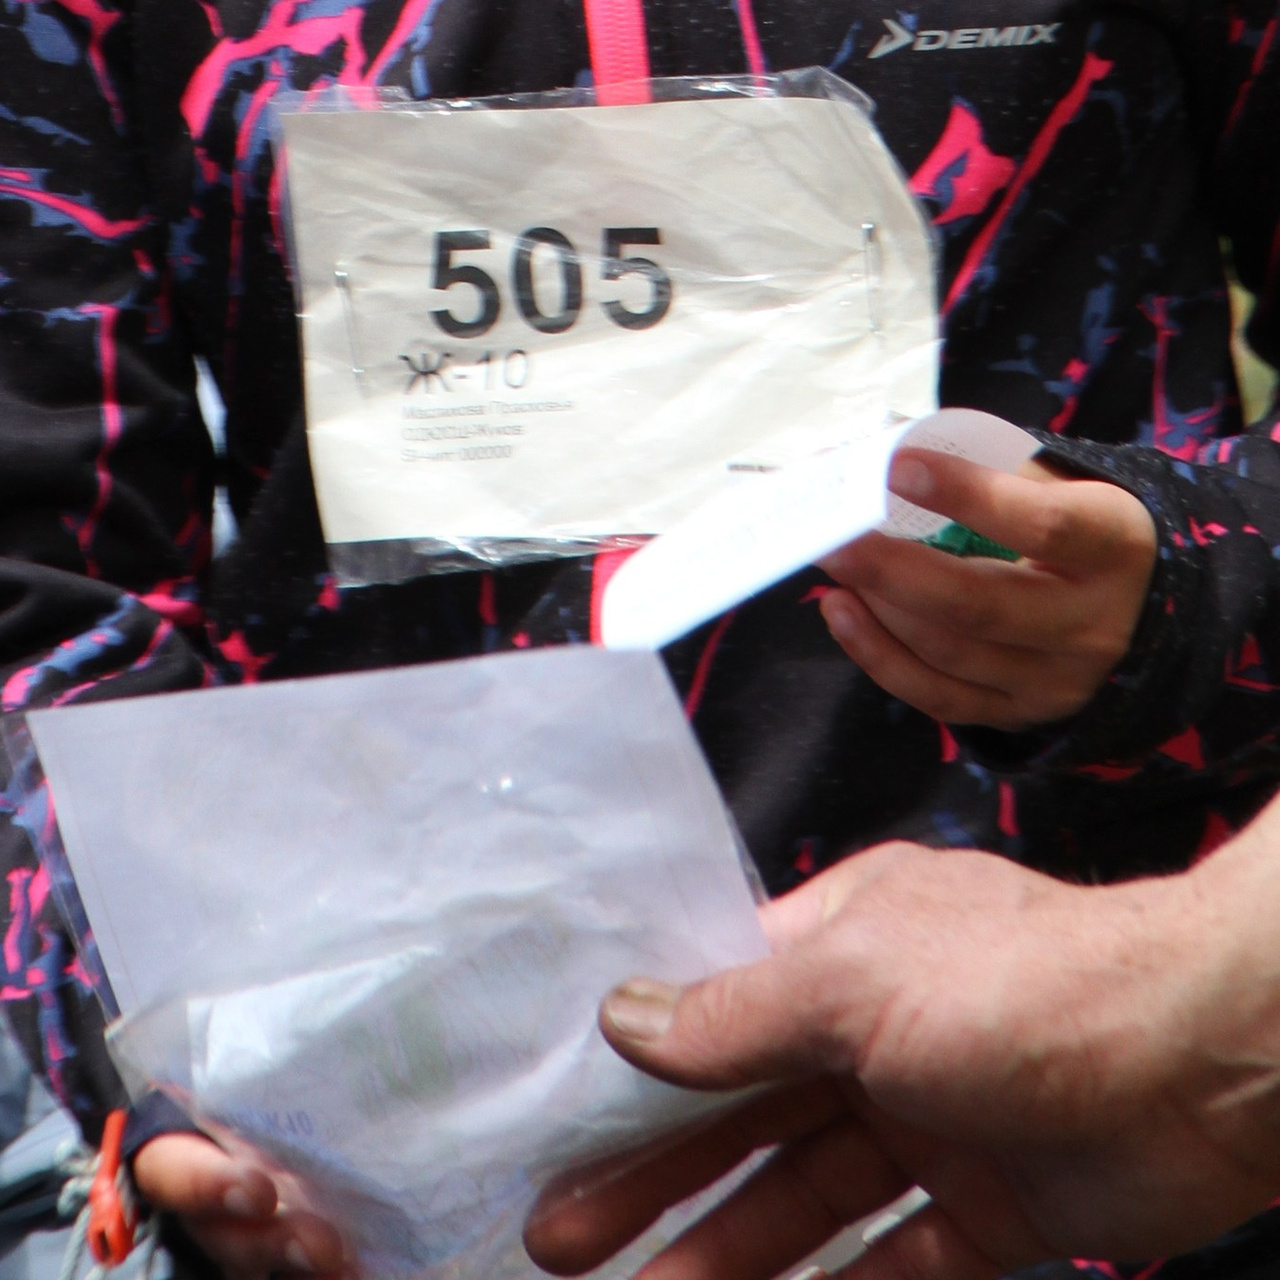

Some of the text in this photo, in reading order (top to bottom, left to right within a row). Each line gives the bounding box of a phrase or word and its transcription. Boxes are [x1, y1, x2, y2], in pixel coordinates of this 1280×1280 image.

[912, 23, 1064, 51] DEMIX
[428, 227, 672, 339] 505
[398, 349, 528, 394] Ж-10
